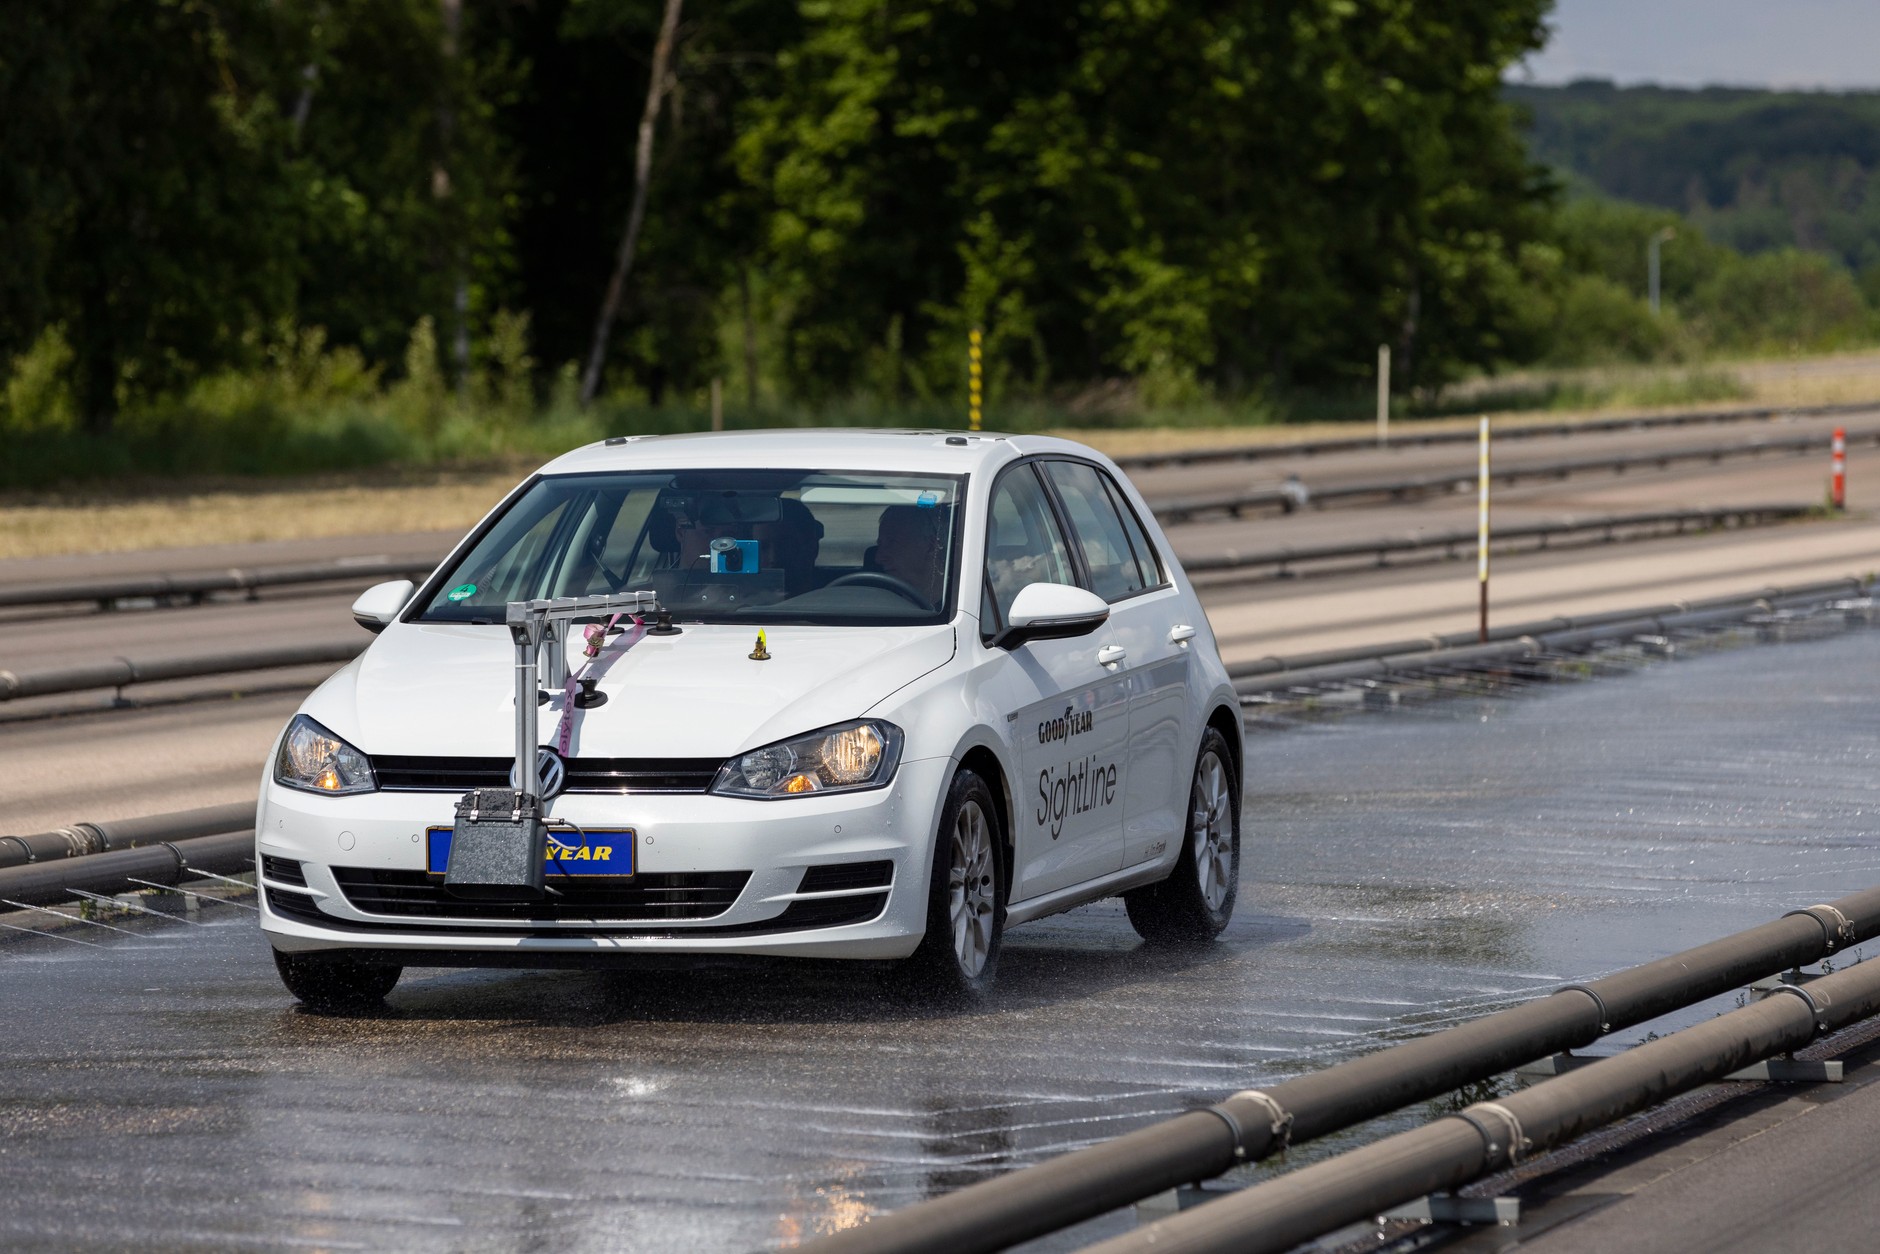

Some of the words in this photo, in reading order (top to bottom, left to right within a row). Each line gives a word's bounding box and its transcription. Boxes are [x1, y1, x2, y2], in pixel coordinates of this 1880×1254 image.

[1039, 705, 1092, 745] GOODYEAR
[1037, 755, 1117, 841] SightLine
[545, 846, 613, 861] YEAR
